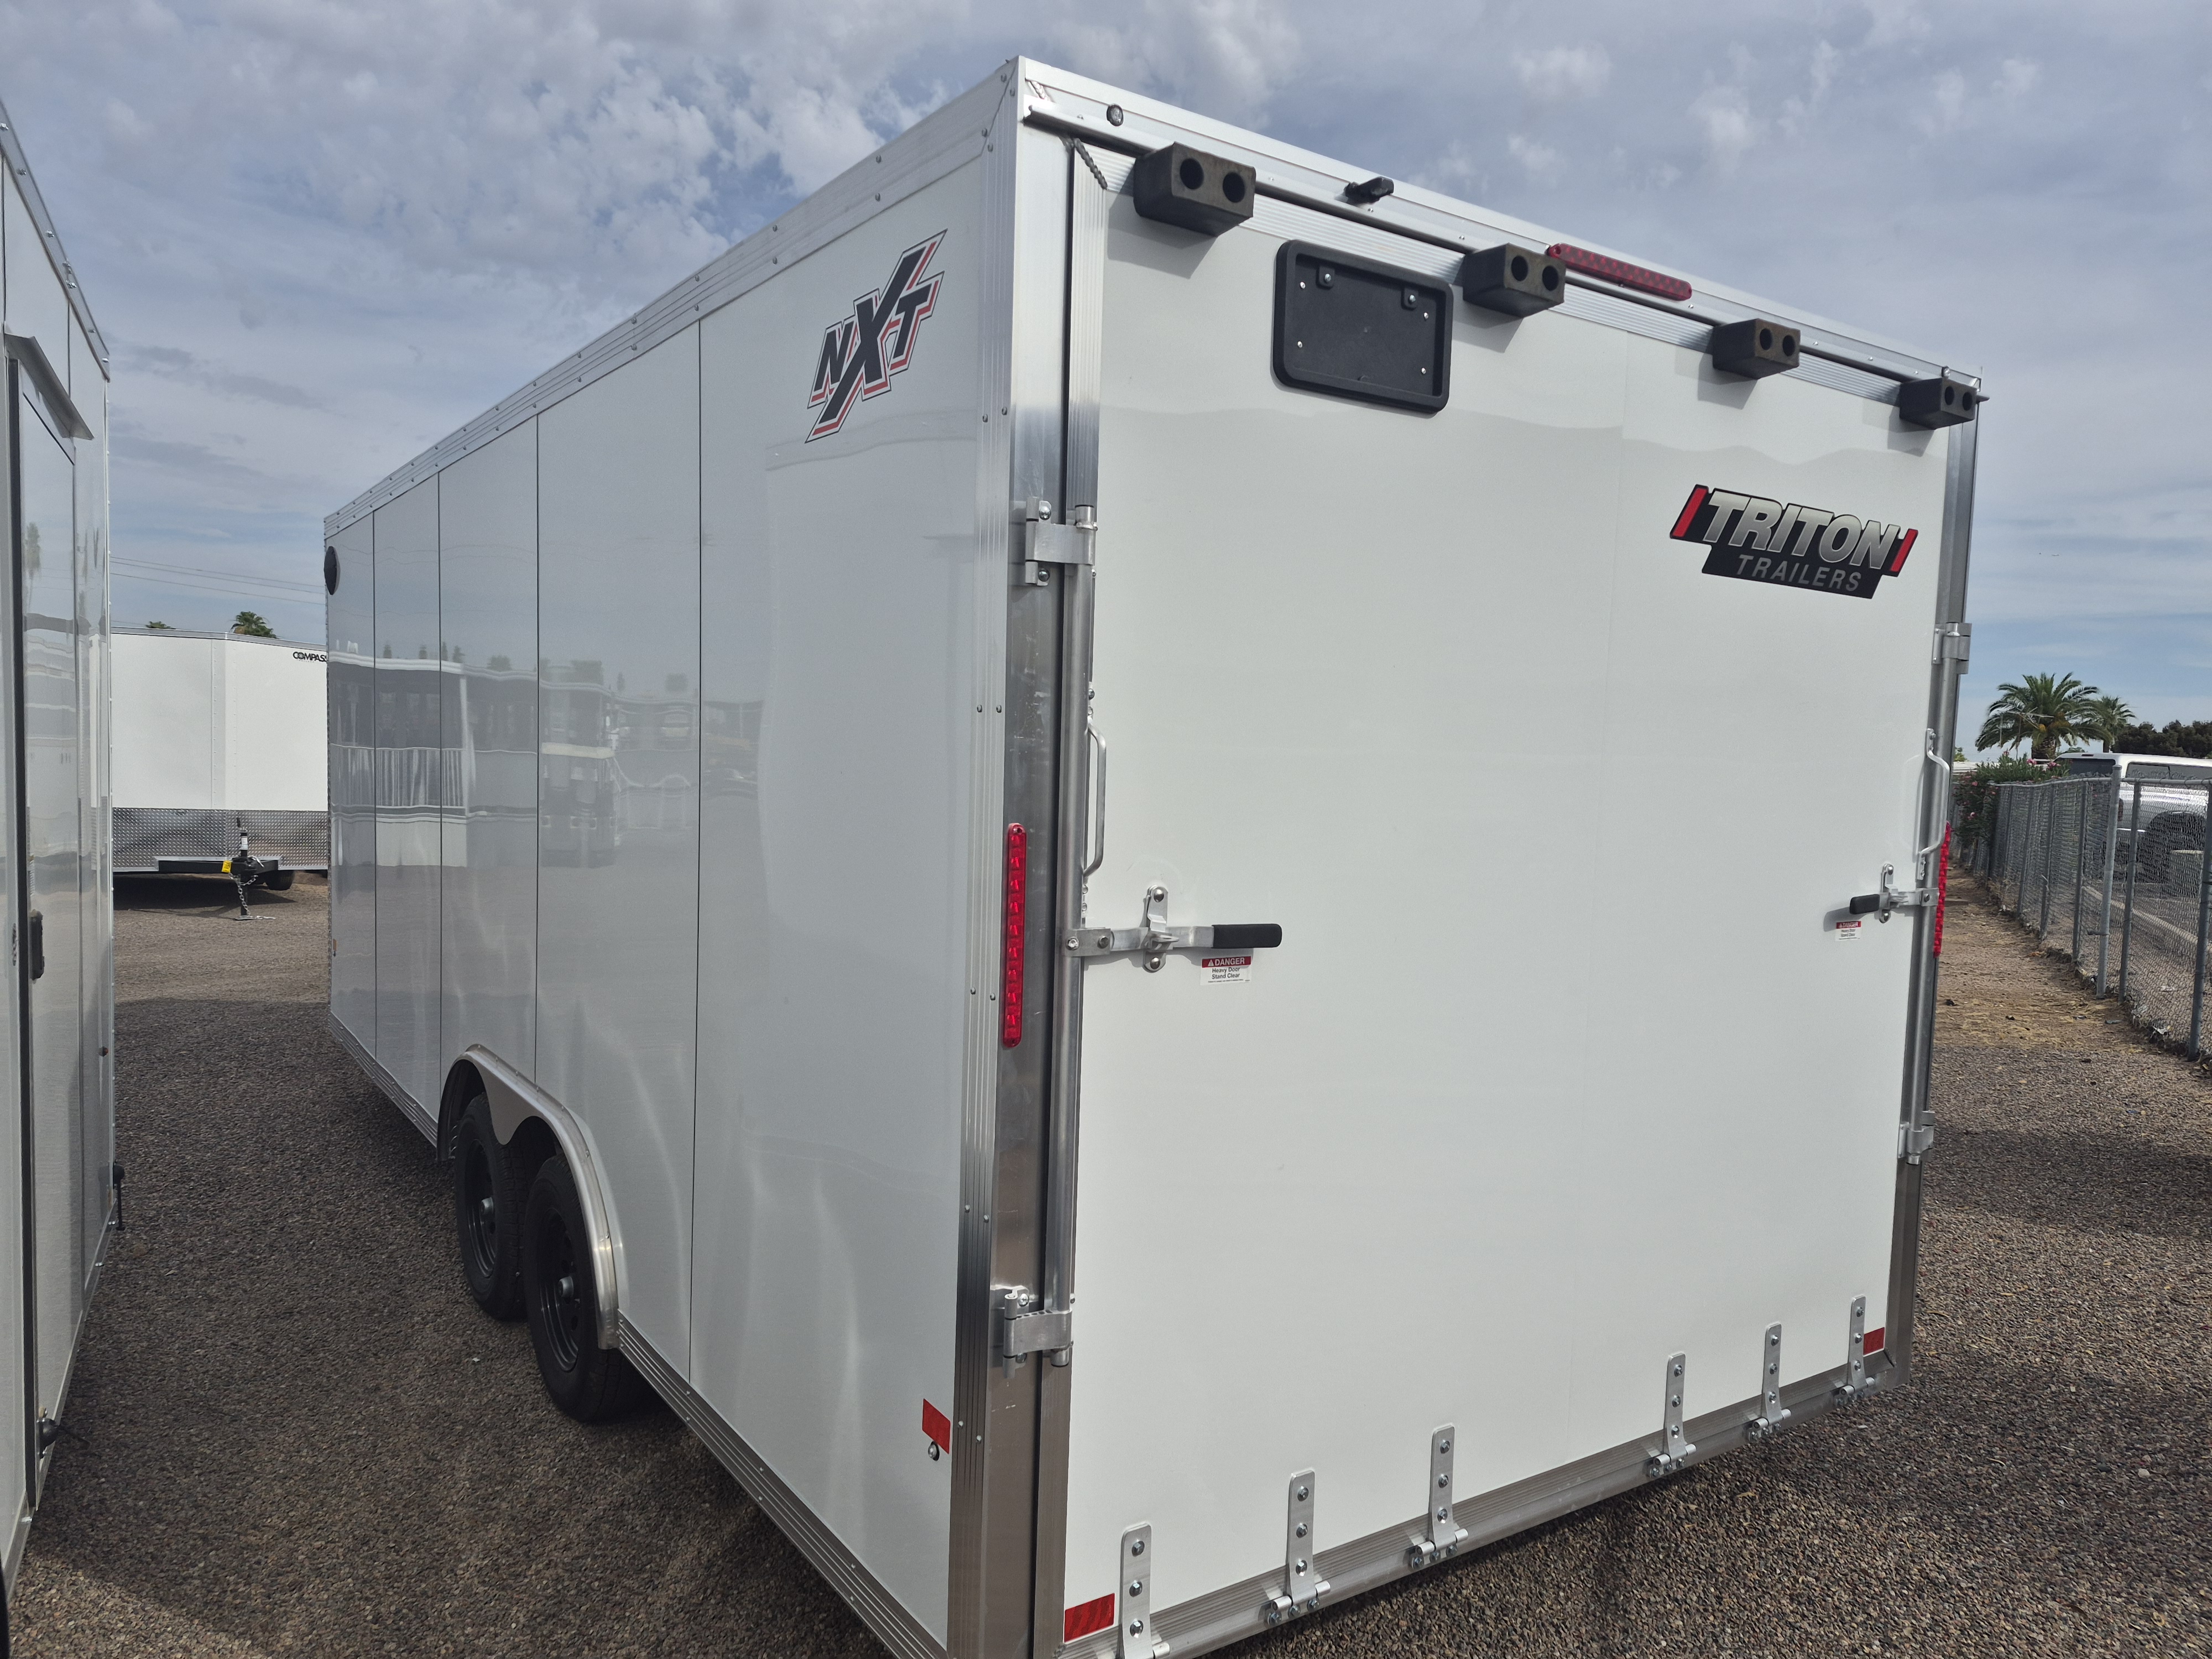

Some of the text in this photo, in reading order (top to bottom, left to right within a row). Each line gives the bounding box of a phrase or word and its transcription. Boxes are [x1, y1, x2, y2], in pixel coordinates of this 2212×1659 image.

[811, 239, 940, 436] NXT
[1703, 490, 1901, 570] TRITON
[1736, 554, 1862, 592] TRAILERS
[1214, 957, 1245, 966] DANGER
